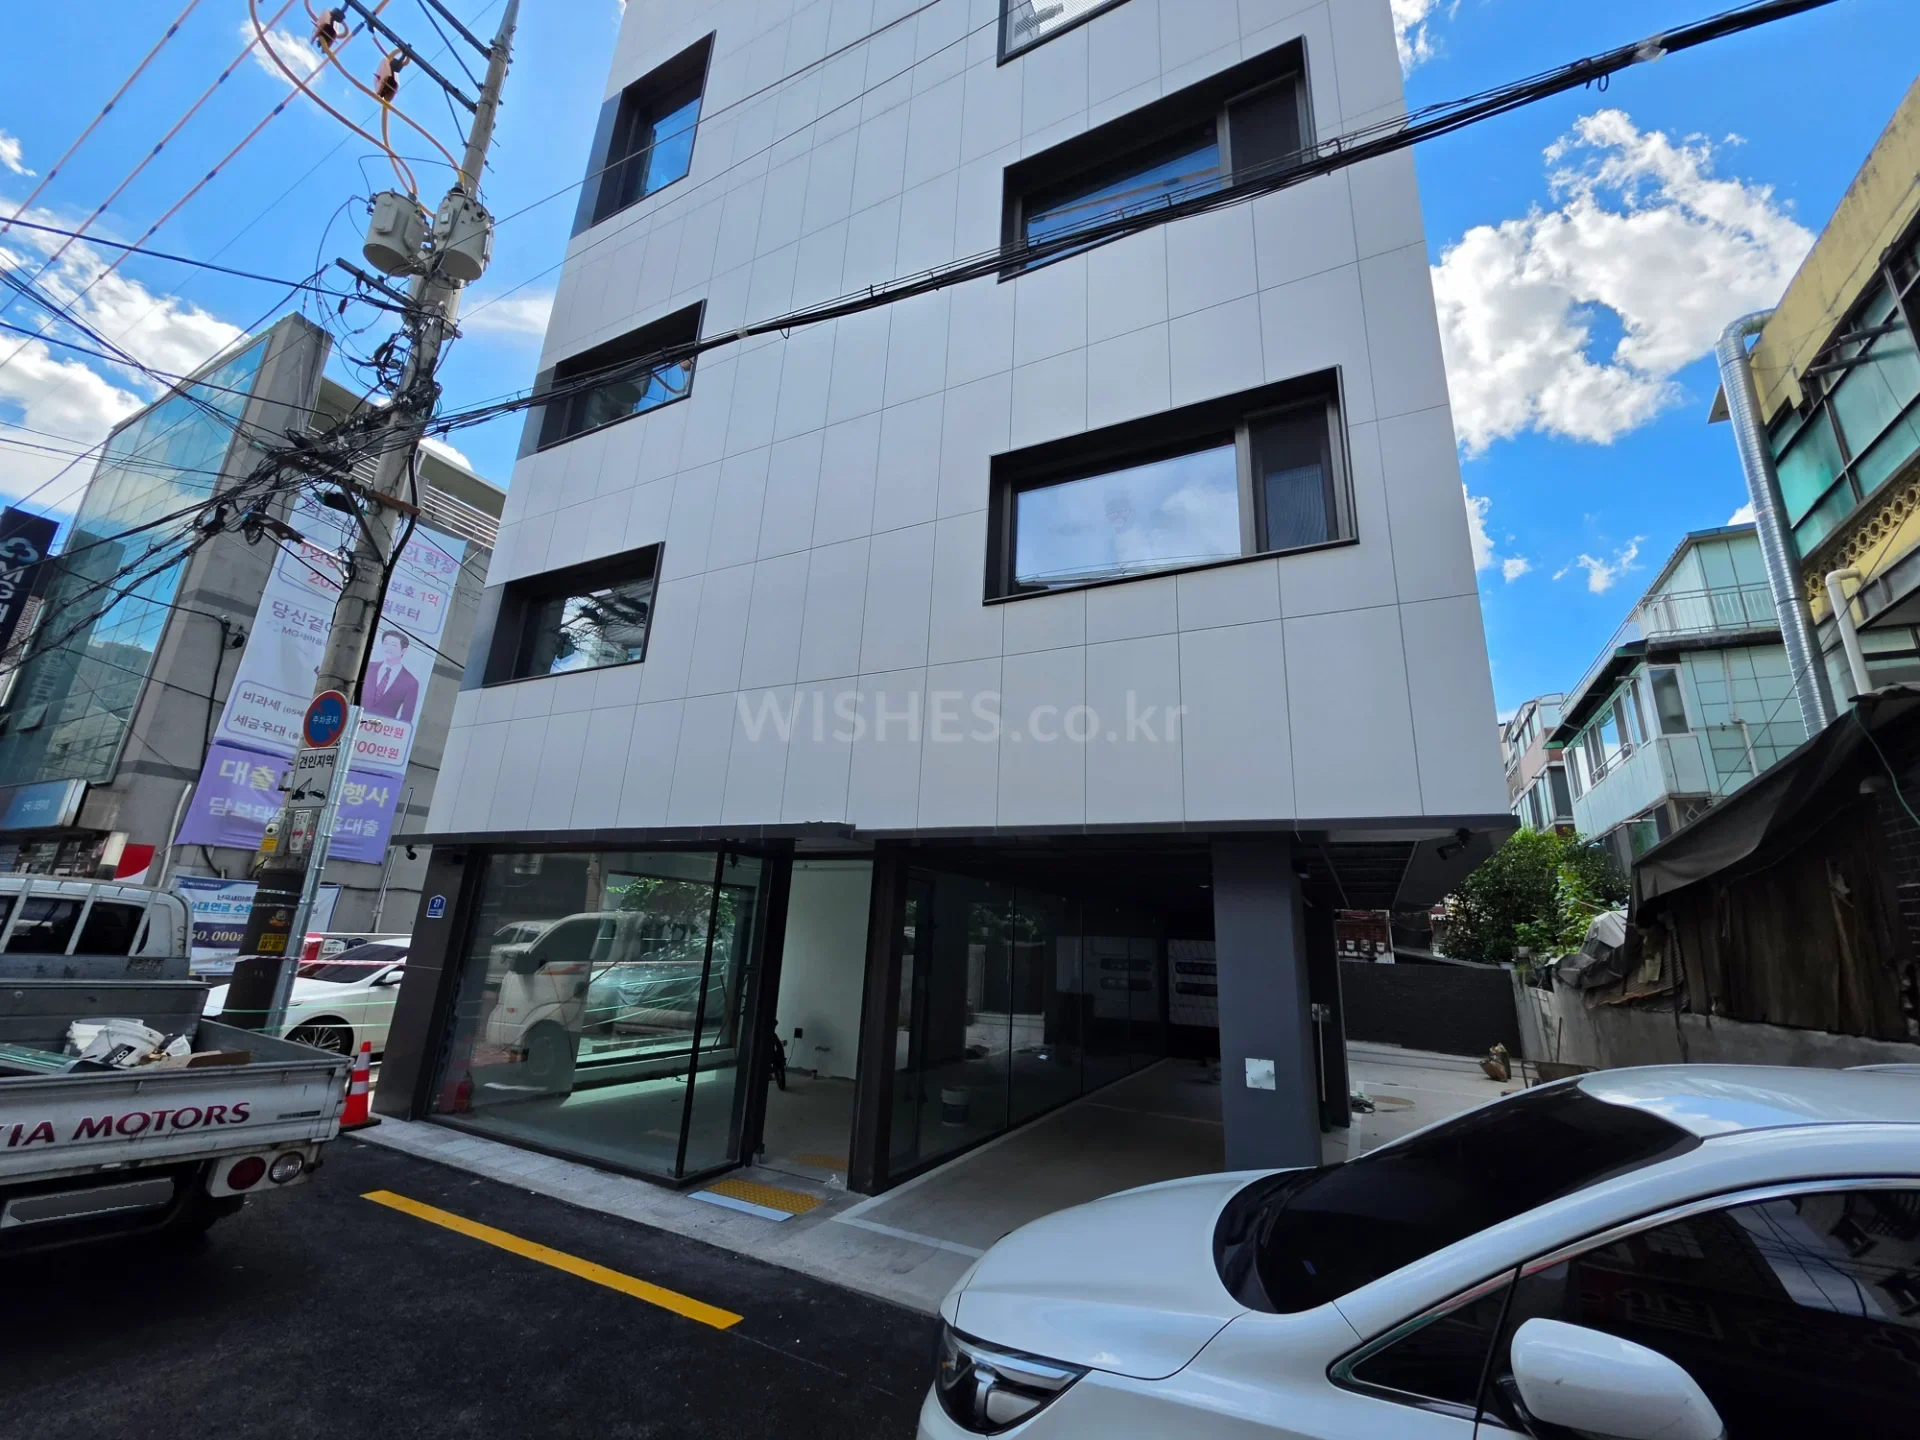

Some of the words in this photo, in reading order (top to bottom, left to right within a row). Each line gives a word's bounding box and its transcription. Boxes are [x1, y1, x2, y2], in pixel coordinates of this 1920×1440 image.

[388, 580, 416, 599] 보호
[419, 591, 440, 608] 1억
[243, 691, 281, 712] 비과세
[234, 714, 287, 737] 세금우대
[312, 715, 339, 725] 주차금지
[299, 754, 335, 770] 견인지역
[219, 759, 276, 791] 대출
[343, 782, 389, 808] 행사
[211, 901, 231, 913] 연금
[0, 1120, 56, 1148] IA
[72, 1101, 250, 1141] MOTORS
